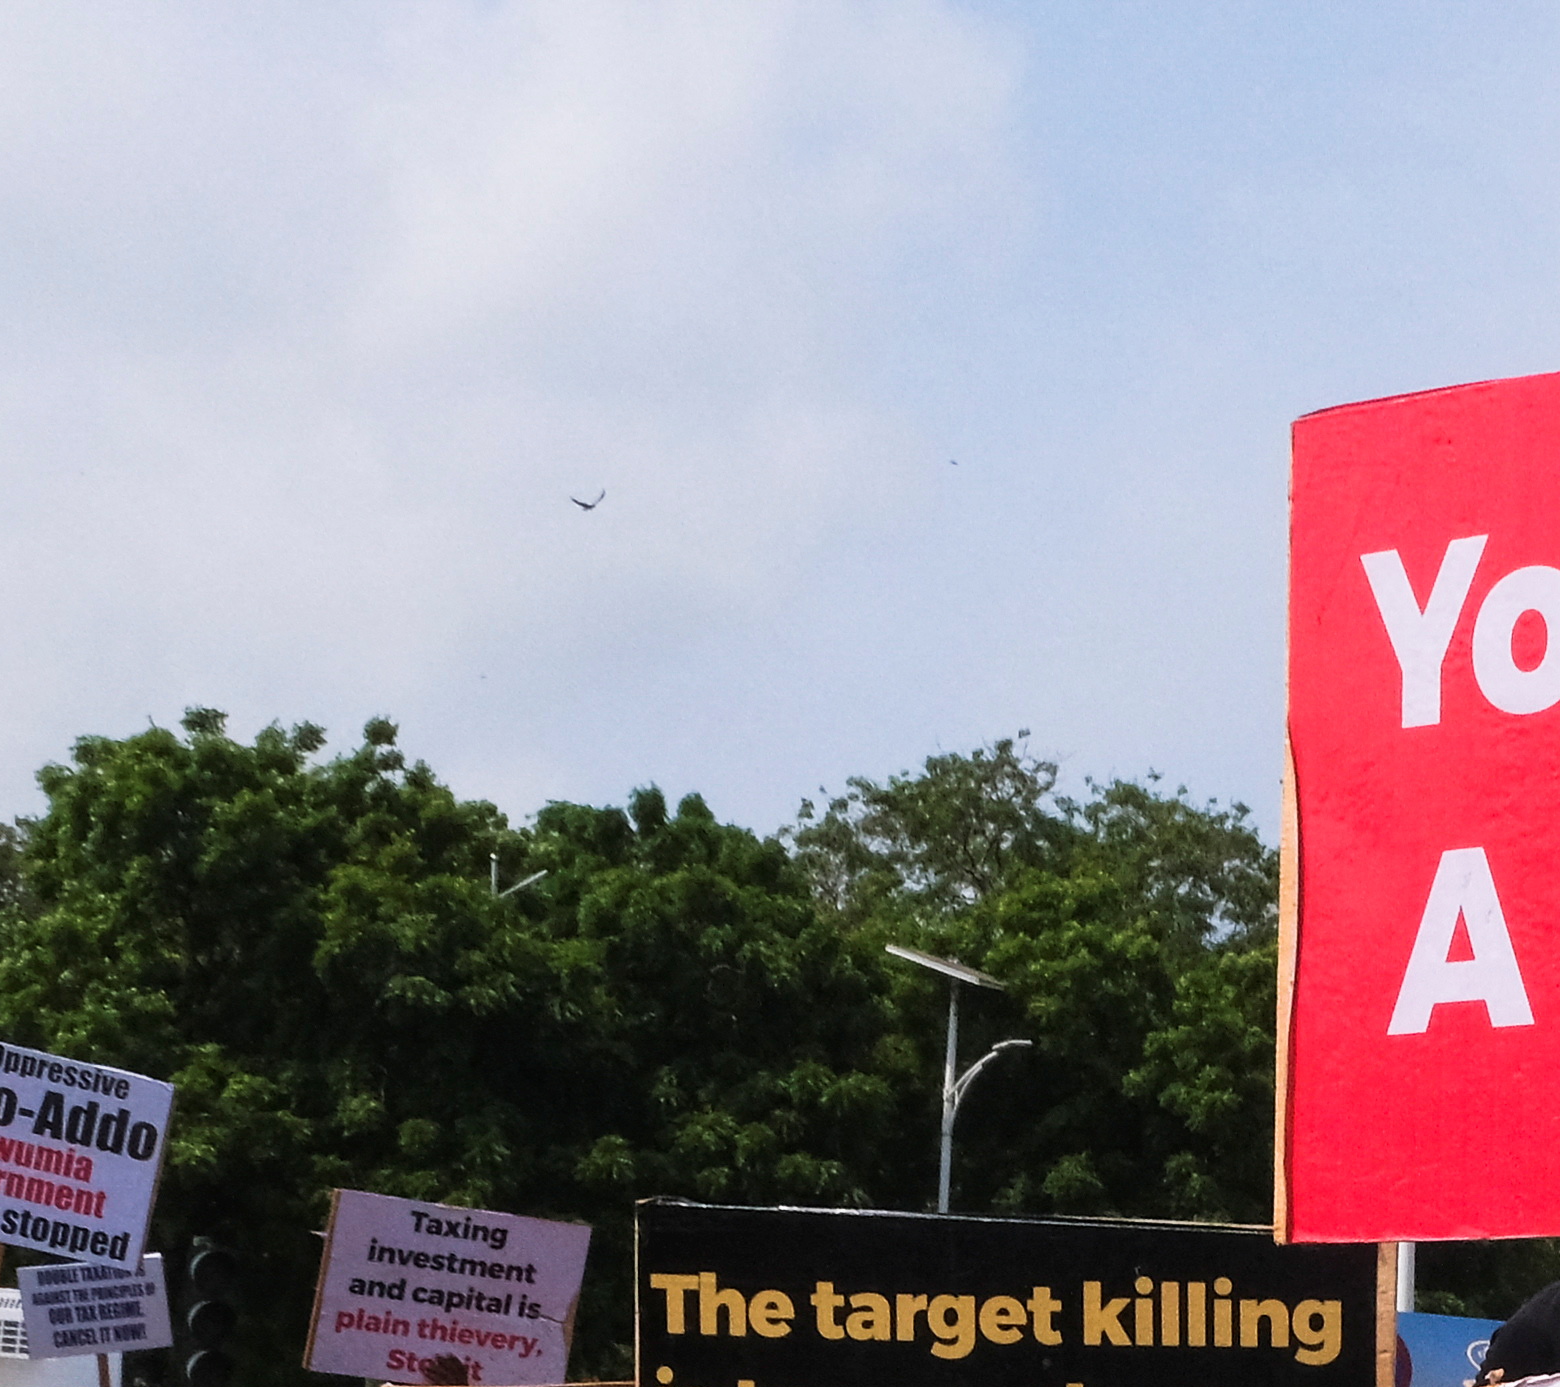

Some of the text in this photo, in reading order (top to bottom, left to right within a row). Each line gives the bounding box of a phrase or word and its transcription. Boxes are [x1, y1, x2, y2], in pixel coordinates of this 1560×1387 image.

[1388, 847, 1534, 1034] A
[1, 1208, 130, 1261] stopped
[411, 1210, 509, 1250] Taxing
[367, 1237, 537, 1284] investment
[75, 1305, 98, 1322] TAX
[348, 1277, 541, 1319] and capital is
[650, 1272, 1341, 1365] The target killing
[54, 1327, 98, 1348] CANCEL
[99, 1327, 110, 1343] IT
[335, 1308, 543, 1358] plain thievery,
